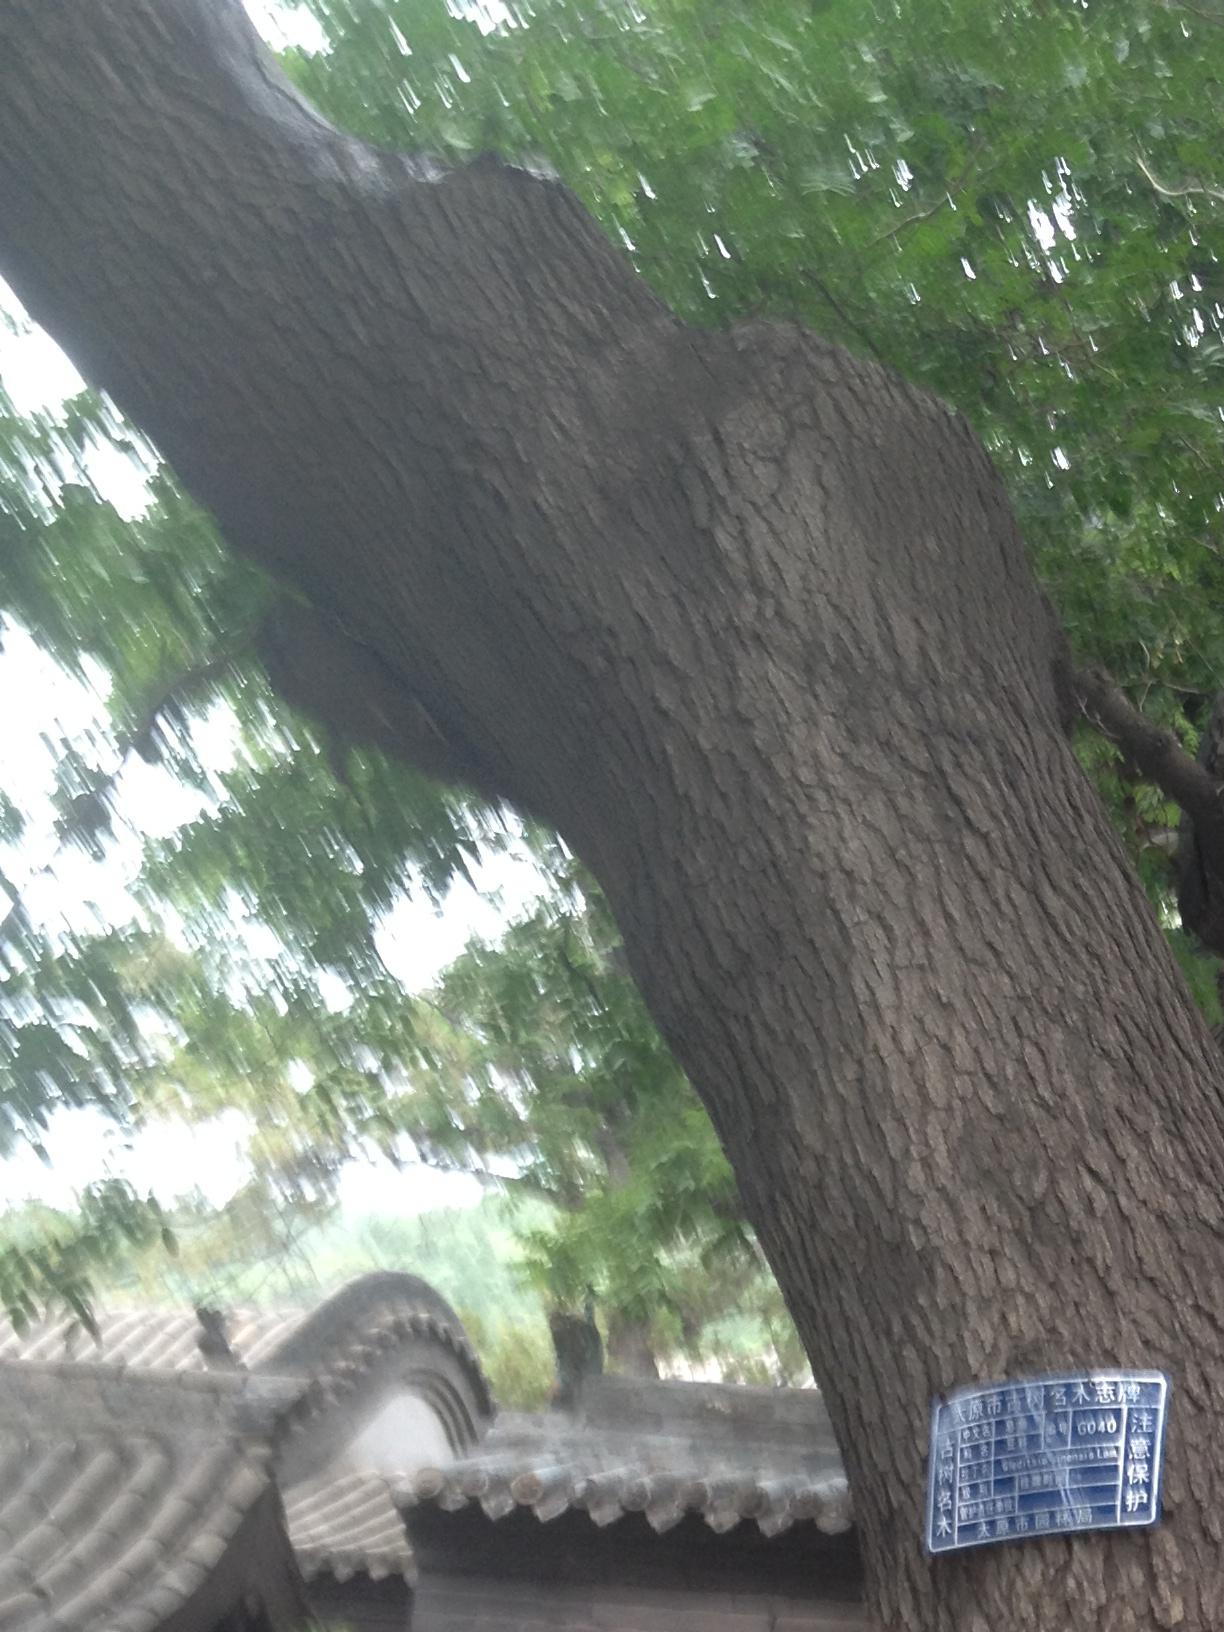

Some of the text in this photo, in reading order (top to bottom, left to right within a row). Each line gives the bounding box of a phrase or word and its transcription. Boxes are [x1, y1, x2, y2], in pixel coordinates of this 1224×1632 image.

[936, 1436, 955, 1538] 古树名木
[1126, 1411, 1154, 1513] 注意保护
